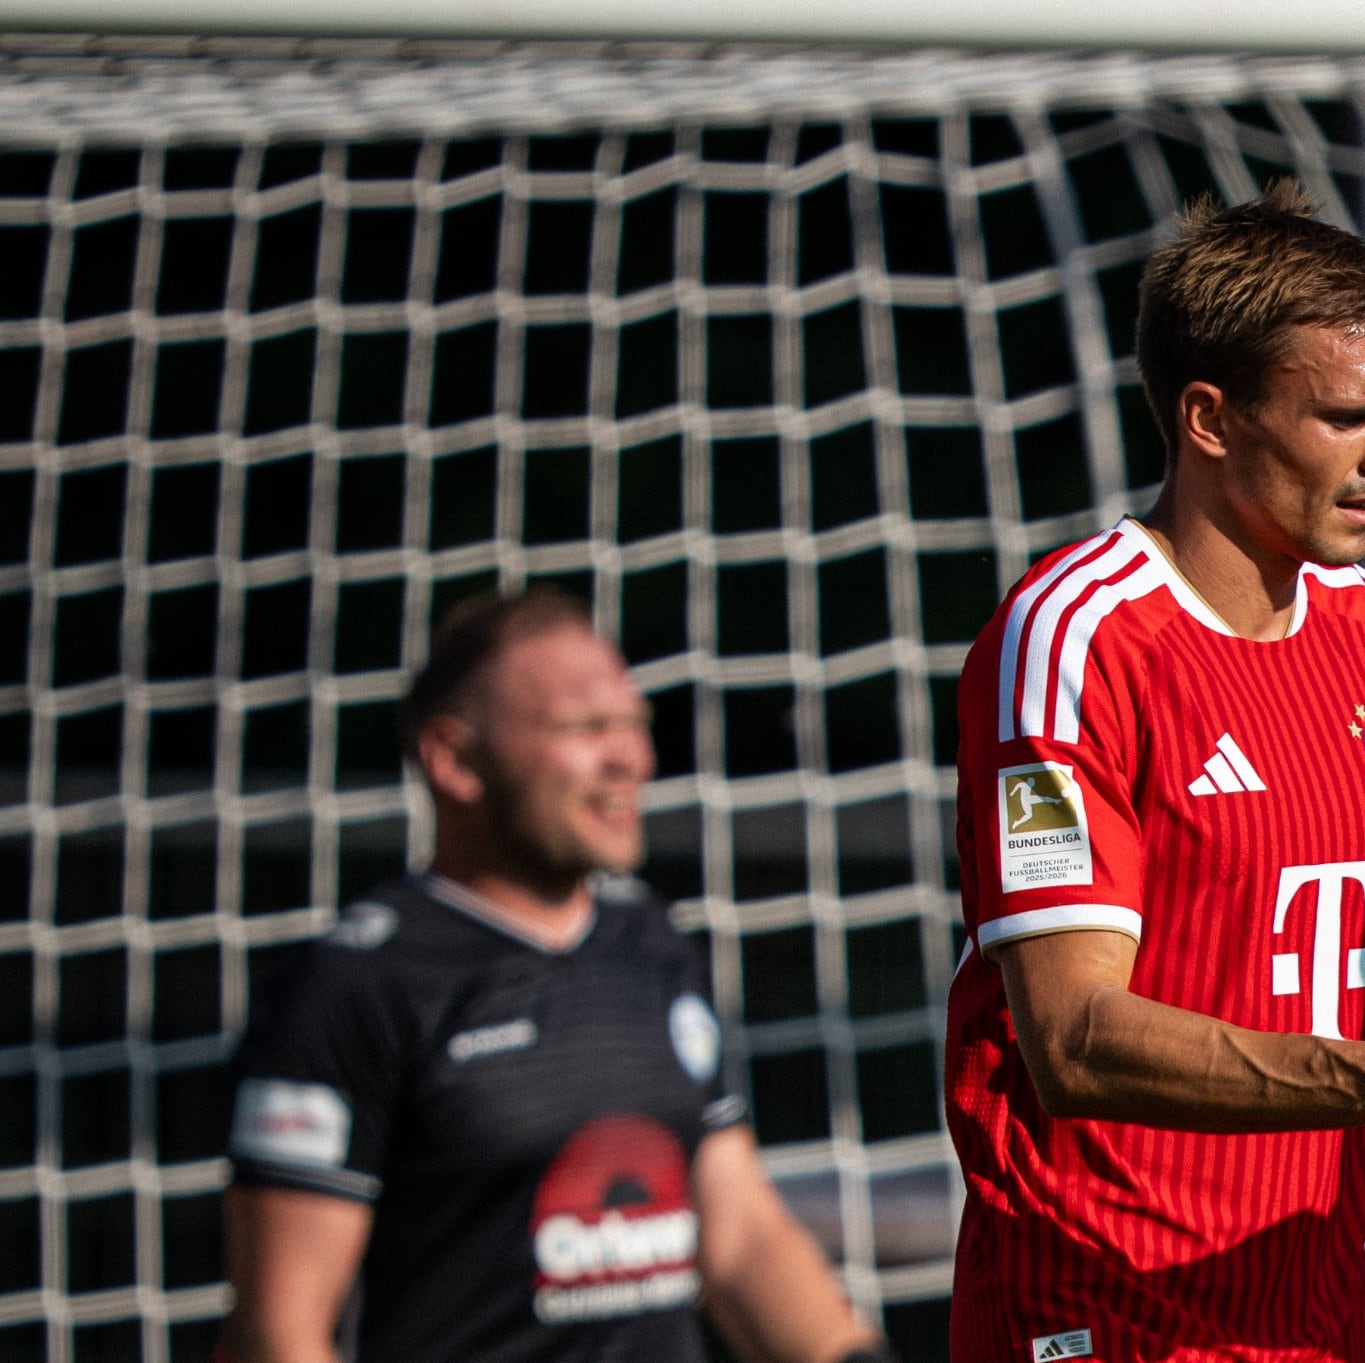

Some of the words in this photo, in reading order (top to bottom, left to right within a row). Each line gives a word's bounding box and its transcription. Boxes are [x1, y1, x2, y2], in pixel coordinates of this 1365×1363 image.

[1008, 833, 1081, 849] BUNDESLIGA
[1022, 858, 1070, 869] DEUTSCHER
[1009, 864, 1084, 877] FUSSBALLMEISTER
